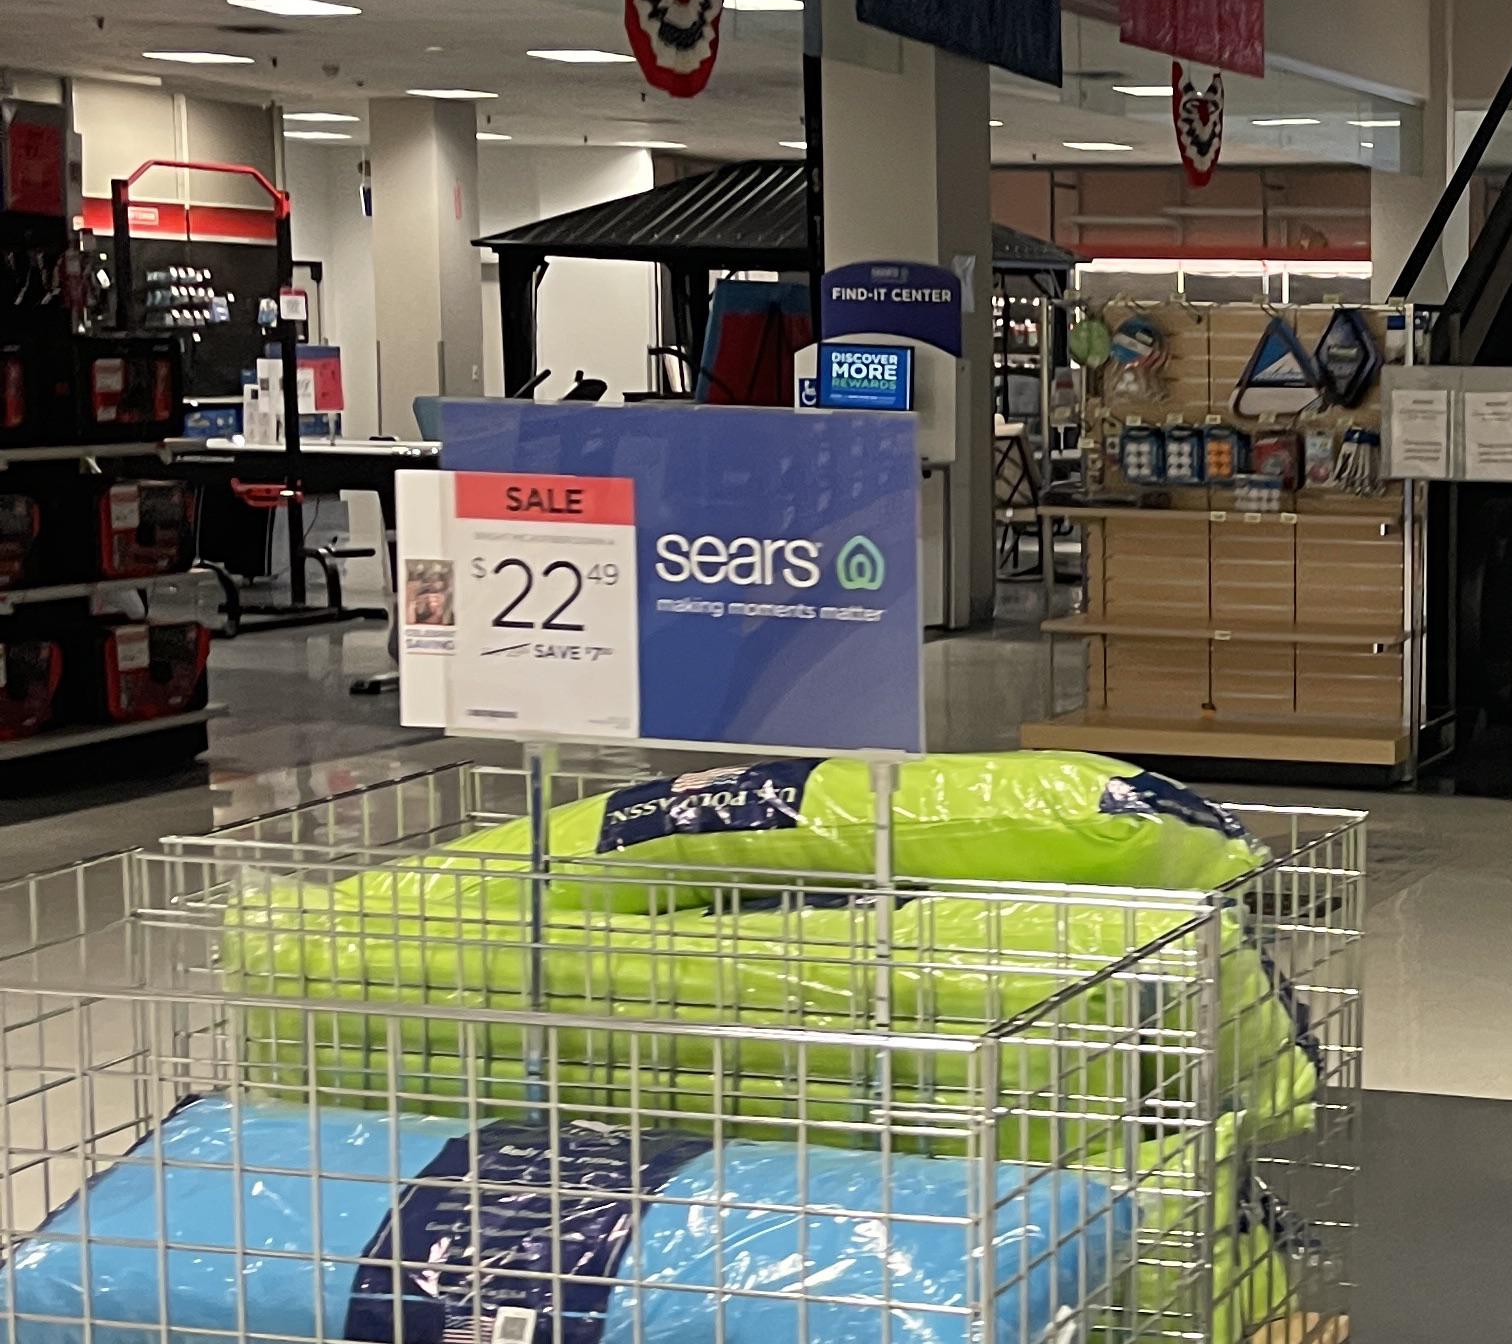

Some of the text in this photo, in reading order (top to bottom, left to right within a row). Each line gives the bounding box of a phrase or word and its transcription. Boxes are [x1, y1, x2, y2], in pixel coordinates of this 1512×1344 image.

[832, 287, 952, 302] FIND-IT CENTER
[831, 352, 898, 365] DISCOVER
[831, 363, 898, 380] MORE
[831, 378, 897, 390] REWARDS
[505, 486, 585, 514] SALE
[655, 533, 821, 588] sears
[727, 602, 817, 619] moments
[819, 606, 888, 622] matter
[533, 643, 582, 660] SAVE
